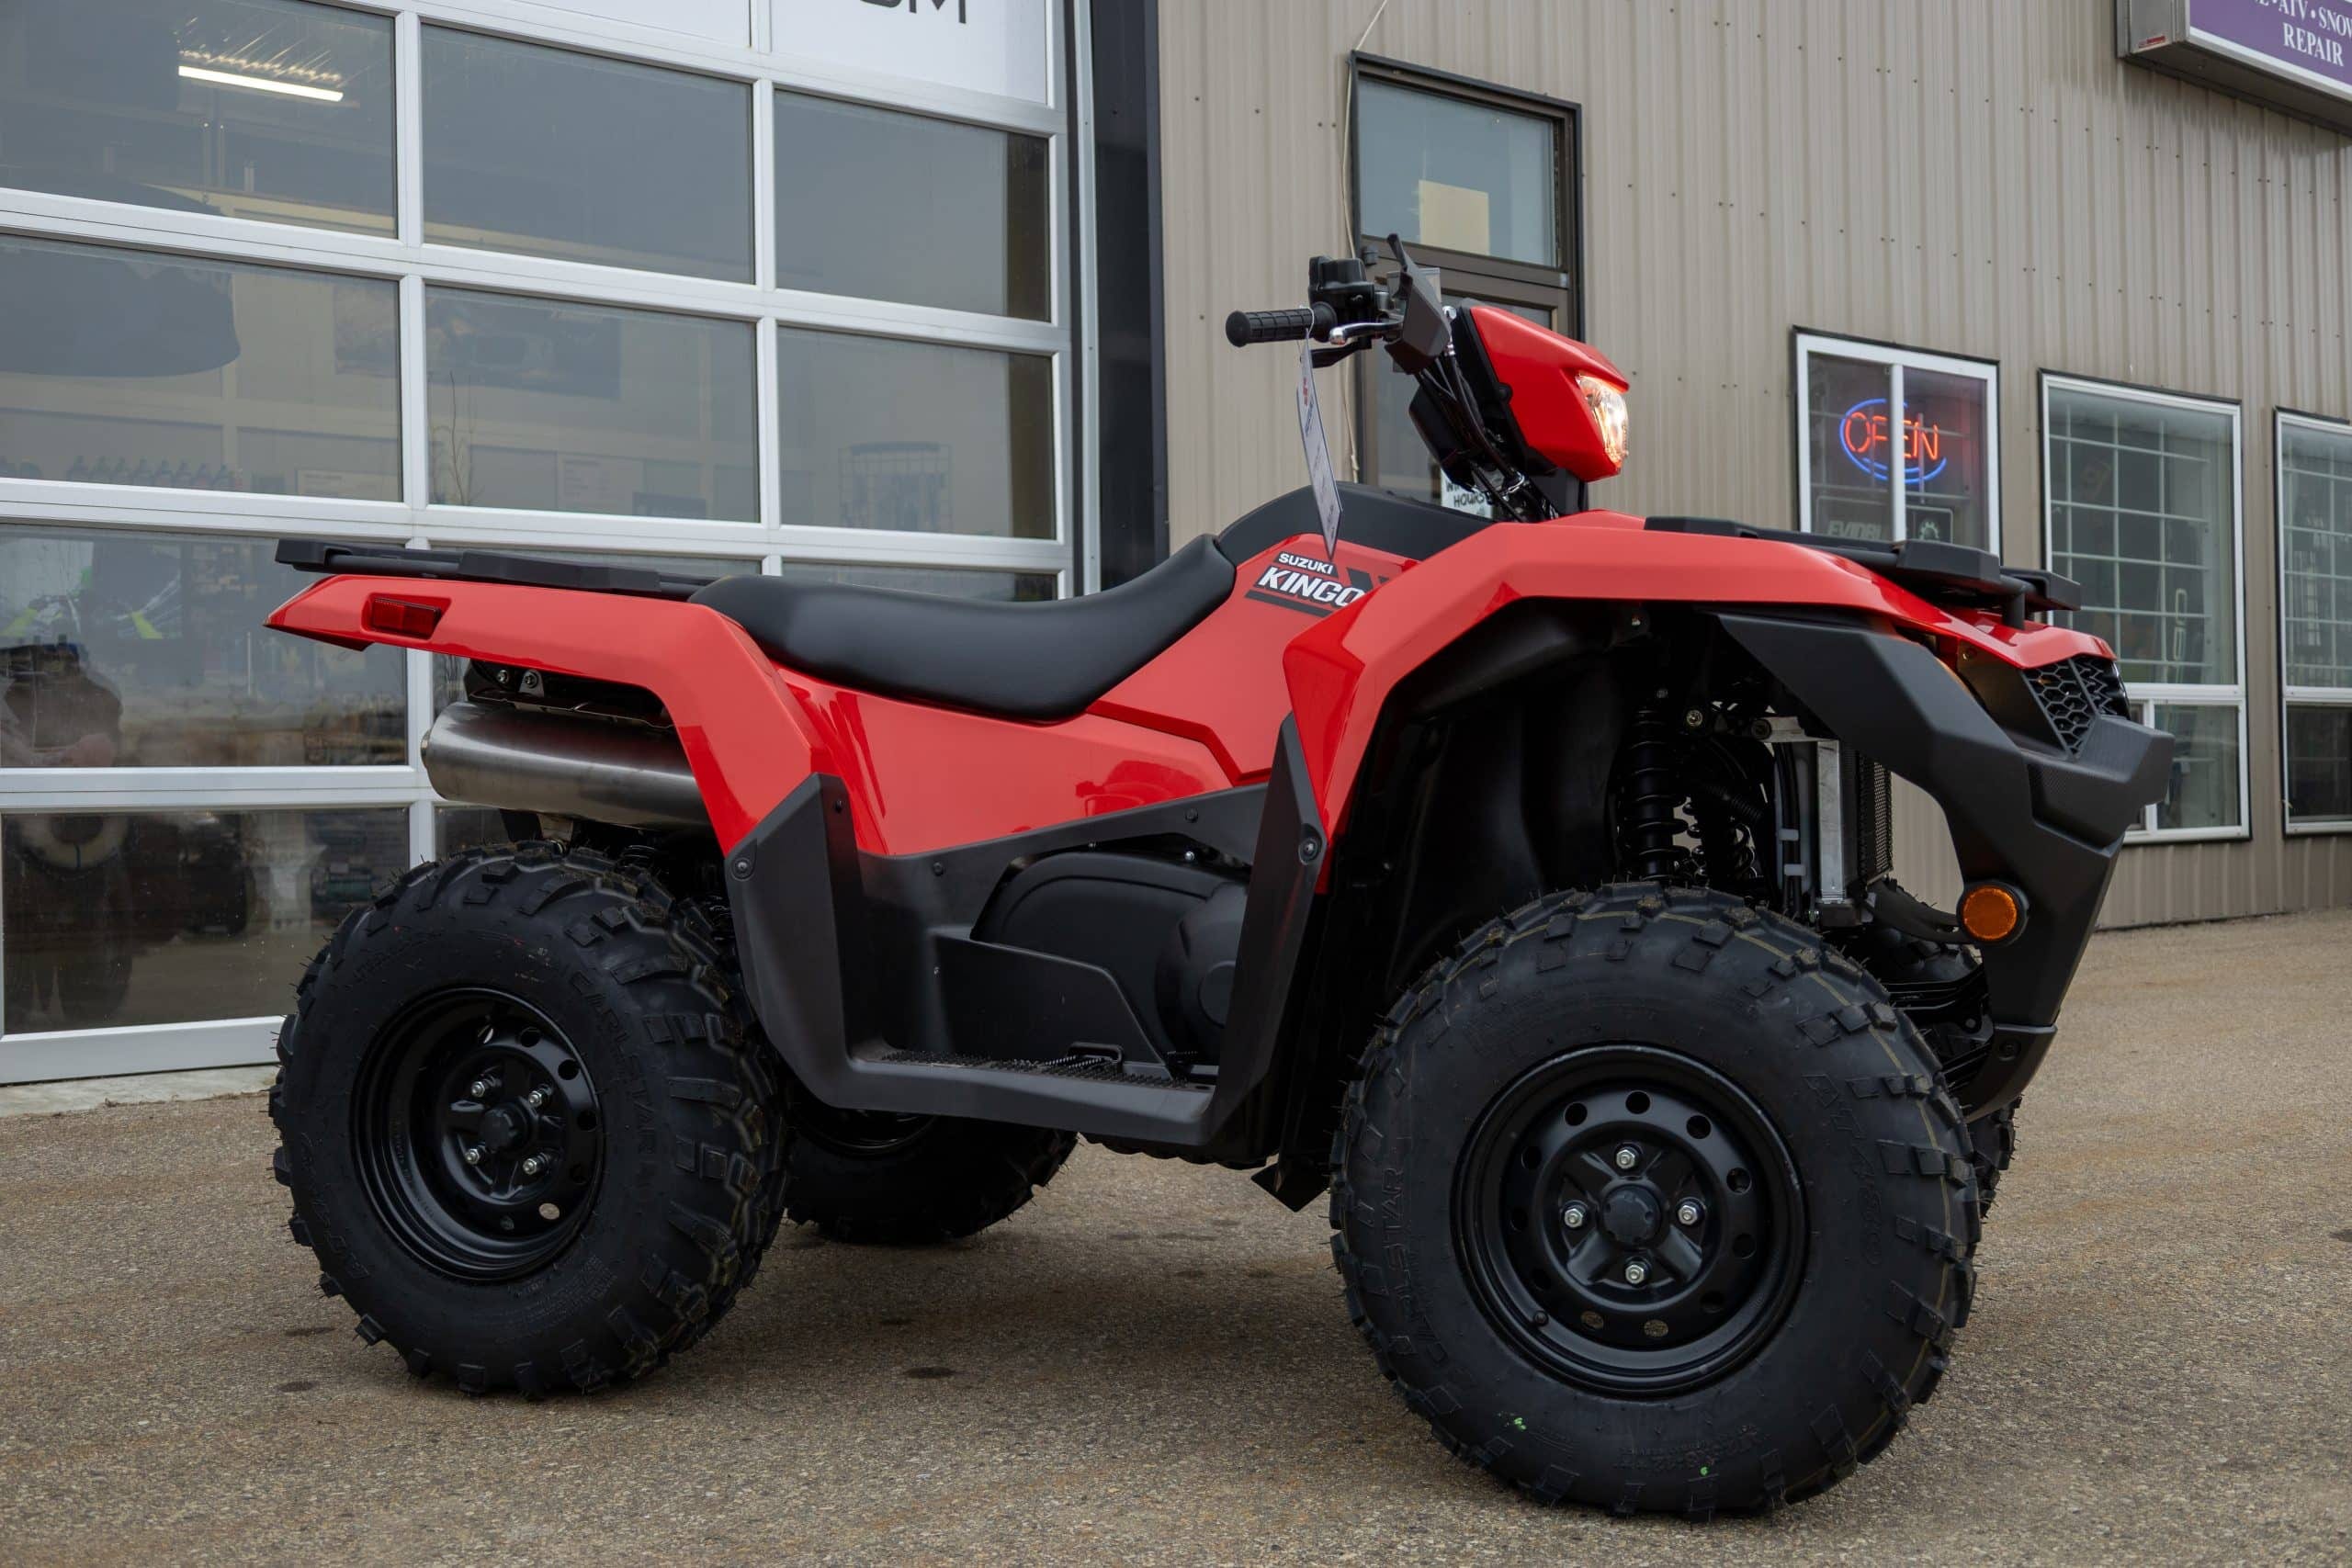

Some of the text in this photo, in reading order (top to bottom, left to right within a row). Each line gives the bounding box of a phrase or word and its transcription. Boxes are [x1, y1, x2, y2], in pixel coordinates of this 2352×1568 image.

[2283, 22, 2344, 67] REPAIR
[1844, 411, 1939, 460] OPEN
[1278, 552, 1334, 575] SUZUKI
